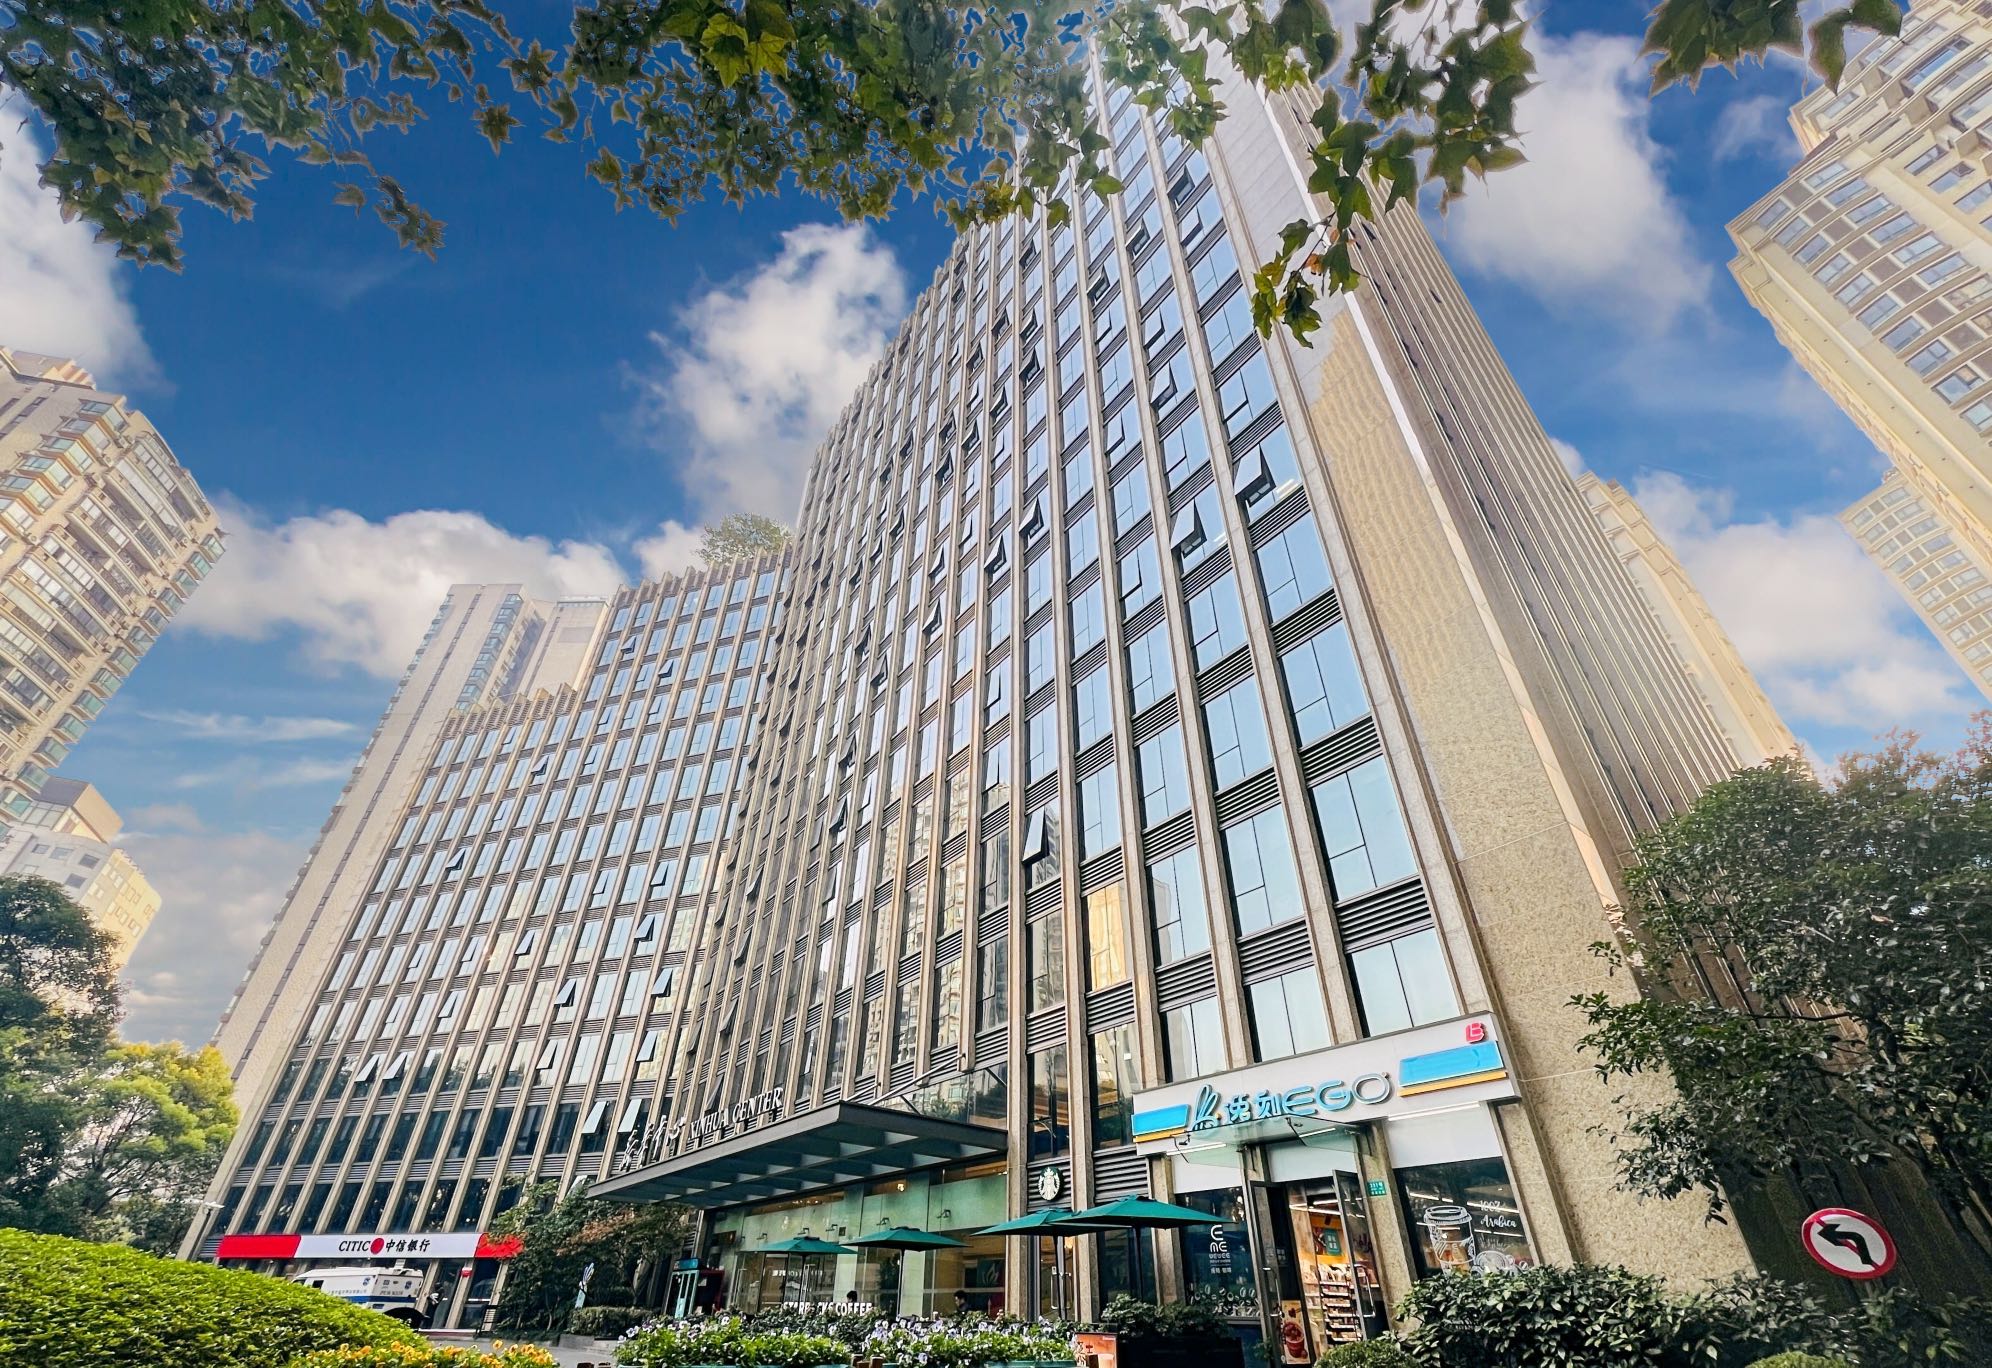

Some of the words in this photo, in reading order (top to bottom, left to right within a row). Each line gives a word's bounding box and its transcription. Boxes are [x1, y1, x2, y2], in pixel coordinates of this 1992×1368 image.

[1282, 1073, 1390, 1116] EGO
[688, 1107, 729, 1140] XINHUA
[732, 1087, 784, 1123] CENTER
[1480, 1214, 1518, 1228] Arabica
[338, 1240, 371, 1252] CITIC
[386, 1239, 431, 1252] 中信银行
